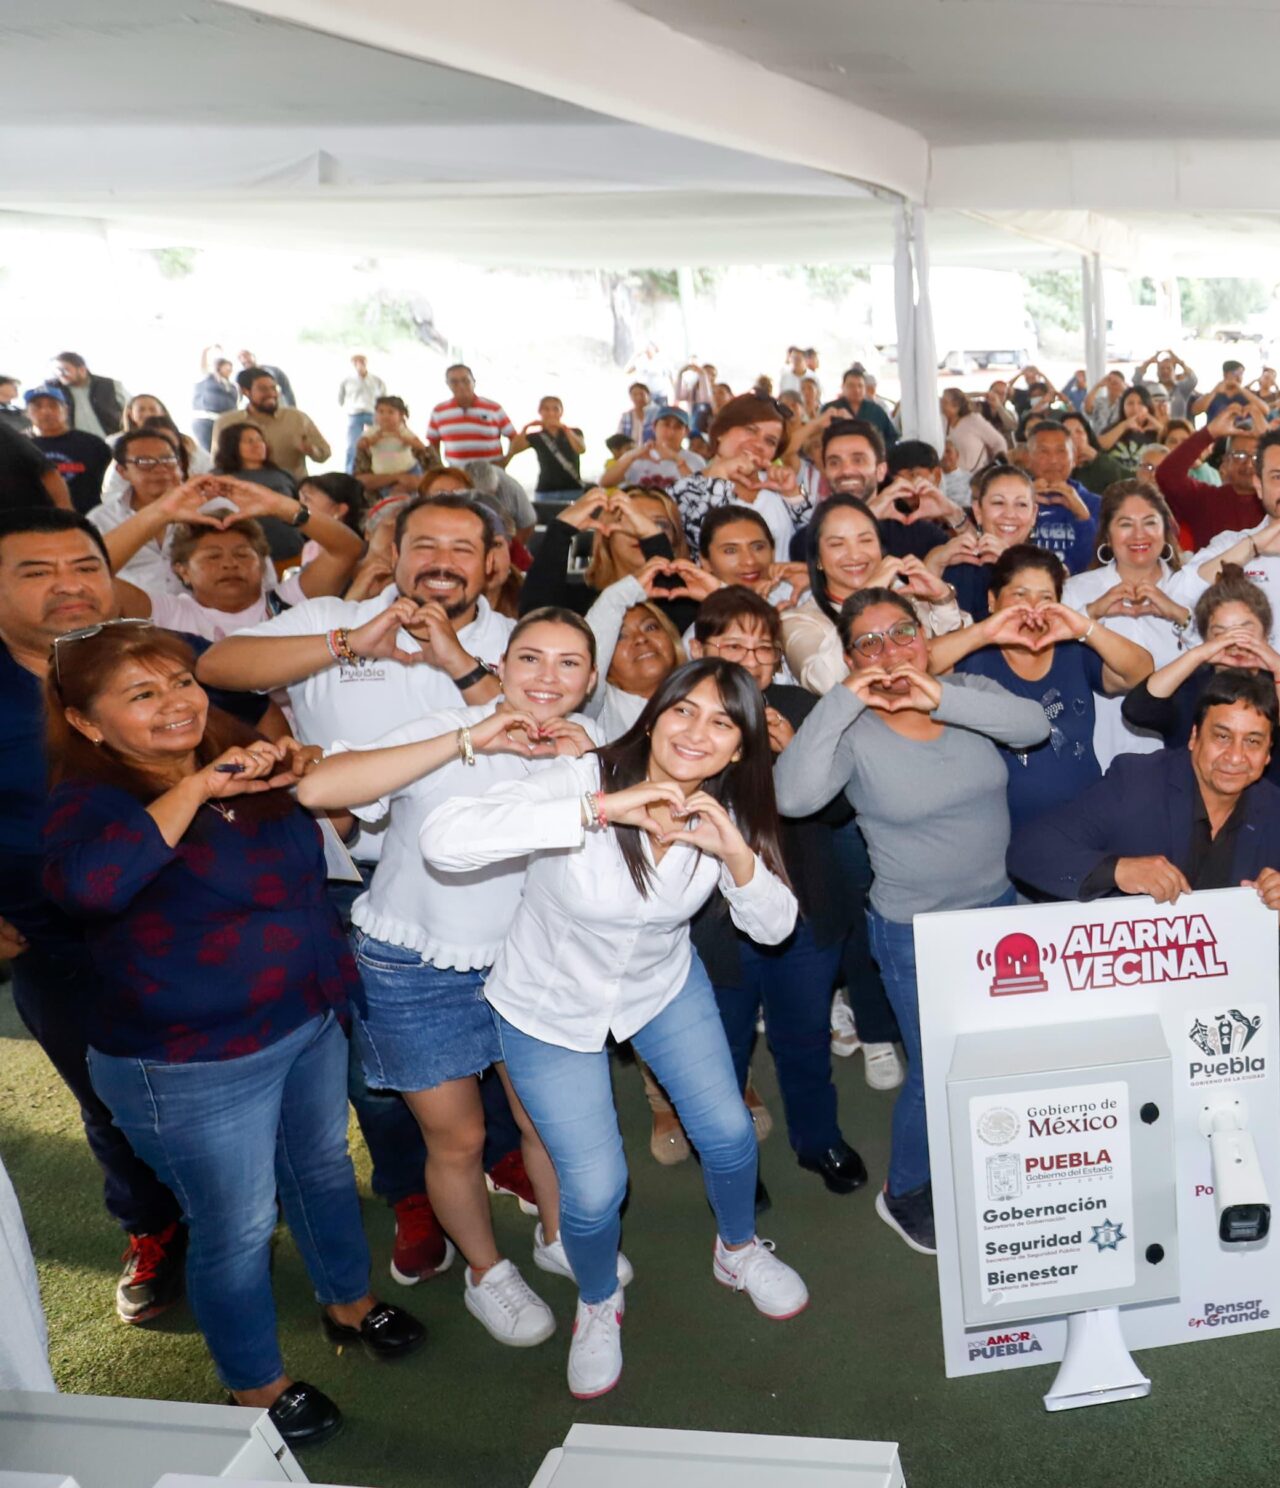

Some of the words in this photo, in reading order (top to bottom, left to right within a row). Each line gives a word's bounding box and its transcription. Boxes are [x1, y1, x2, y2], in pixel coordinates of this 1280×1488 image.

[1061, 914, 1217, 959] ALARMA
[1063, 944, 1228, 991] VECINAL
[1189, 1056, 1266, 1080] Puebla
[1027, 1102, 1097, 1118] Gobierno
[1101, 1098, 1117, 1109] de
[1028, 1113, 1118, 1138] México
[1025, 1149, 1112, 1173] PUEBLA
[1026, 1170, 1067, 1182] Gobierno
[1067, 1169, 1081, 1177] del
[1082, 1165, 1113, 1175] Estado
[1195, 1185, 1214, 1197] Po
[983, 1197, 1107, 1224] Gobernación
[985, 1231, 1082, 1256] Seguridad
[987, 1264, 1079, 1286] Bienestar
[1204, 1299, 1262, 1316] Pensar
[1206, 1307, 1270, 1327] Grande
[987, 1331, 1031, 1346] AMOR
[968, 1340, 1043, 1361] PUEBLA
